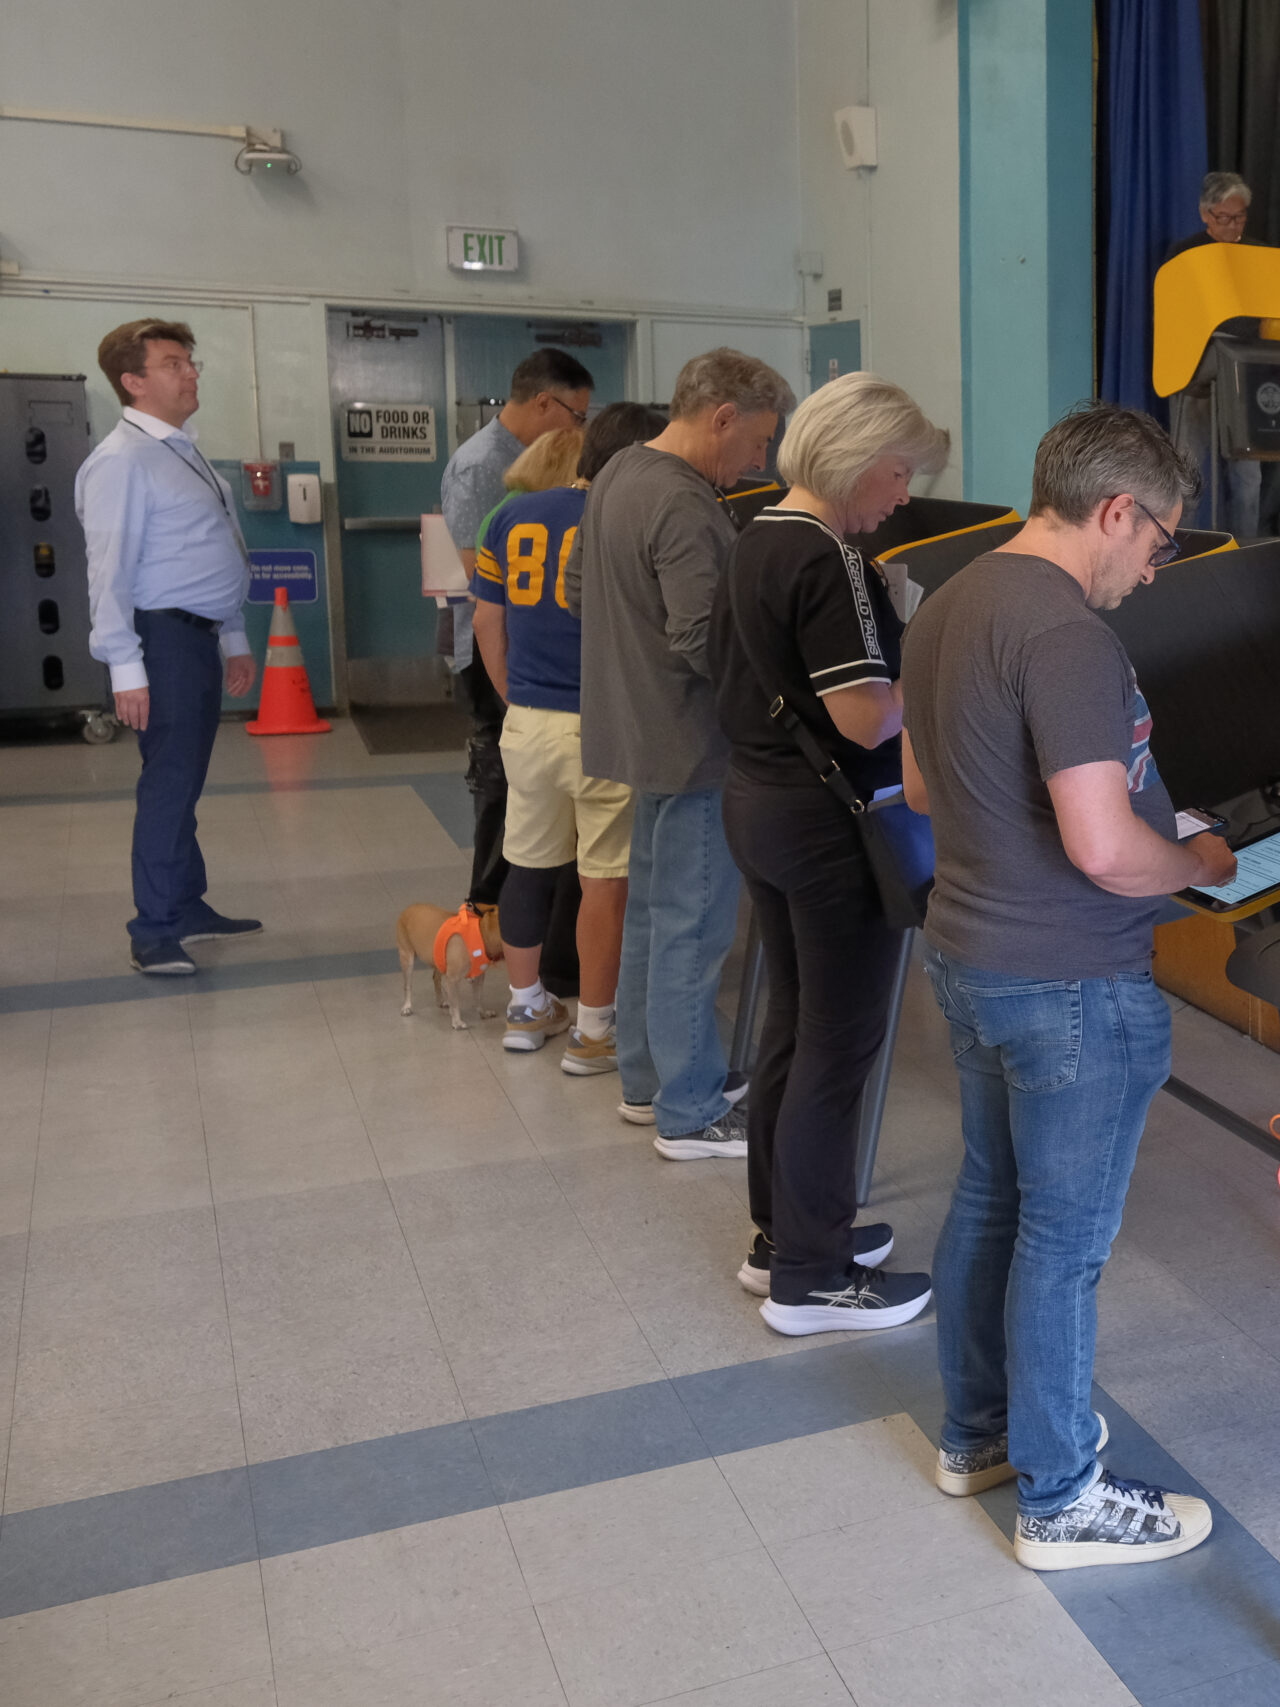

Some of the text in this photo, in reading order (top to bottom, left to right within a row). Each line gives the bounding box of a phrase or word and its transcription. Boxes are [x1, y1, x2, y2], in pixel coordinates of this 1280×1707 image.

[463, 233, 505, 266] EXIT
[348, 411, 371, 434] NO
[376, 410, 430, 425] FOOD OR
[381, 426, 427, 439] DRINKS
[349, 446, 431, 455] IN THE AUDITORIUM
[863, 619, 878, 655] PARIS
